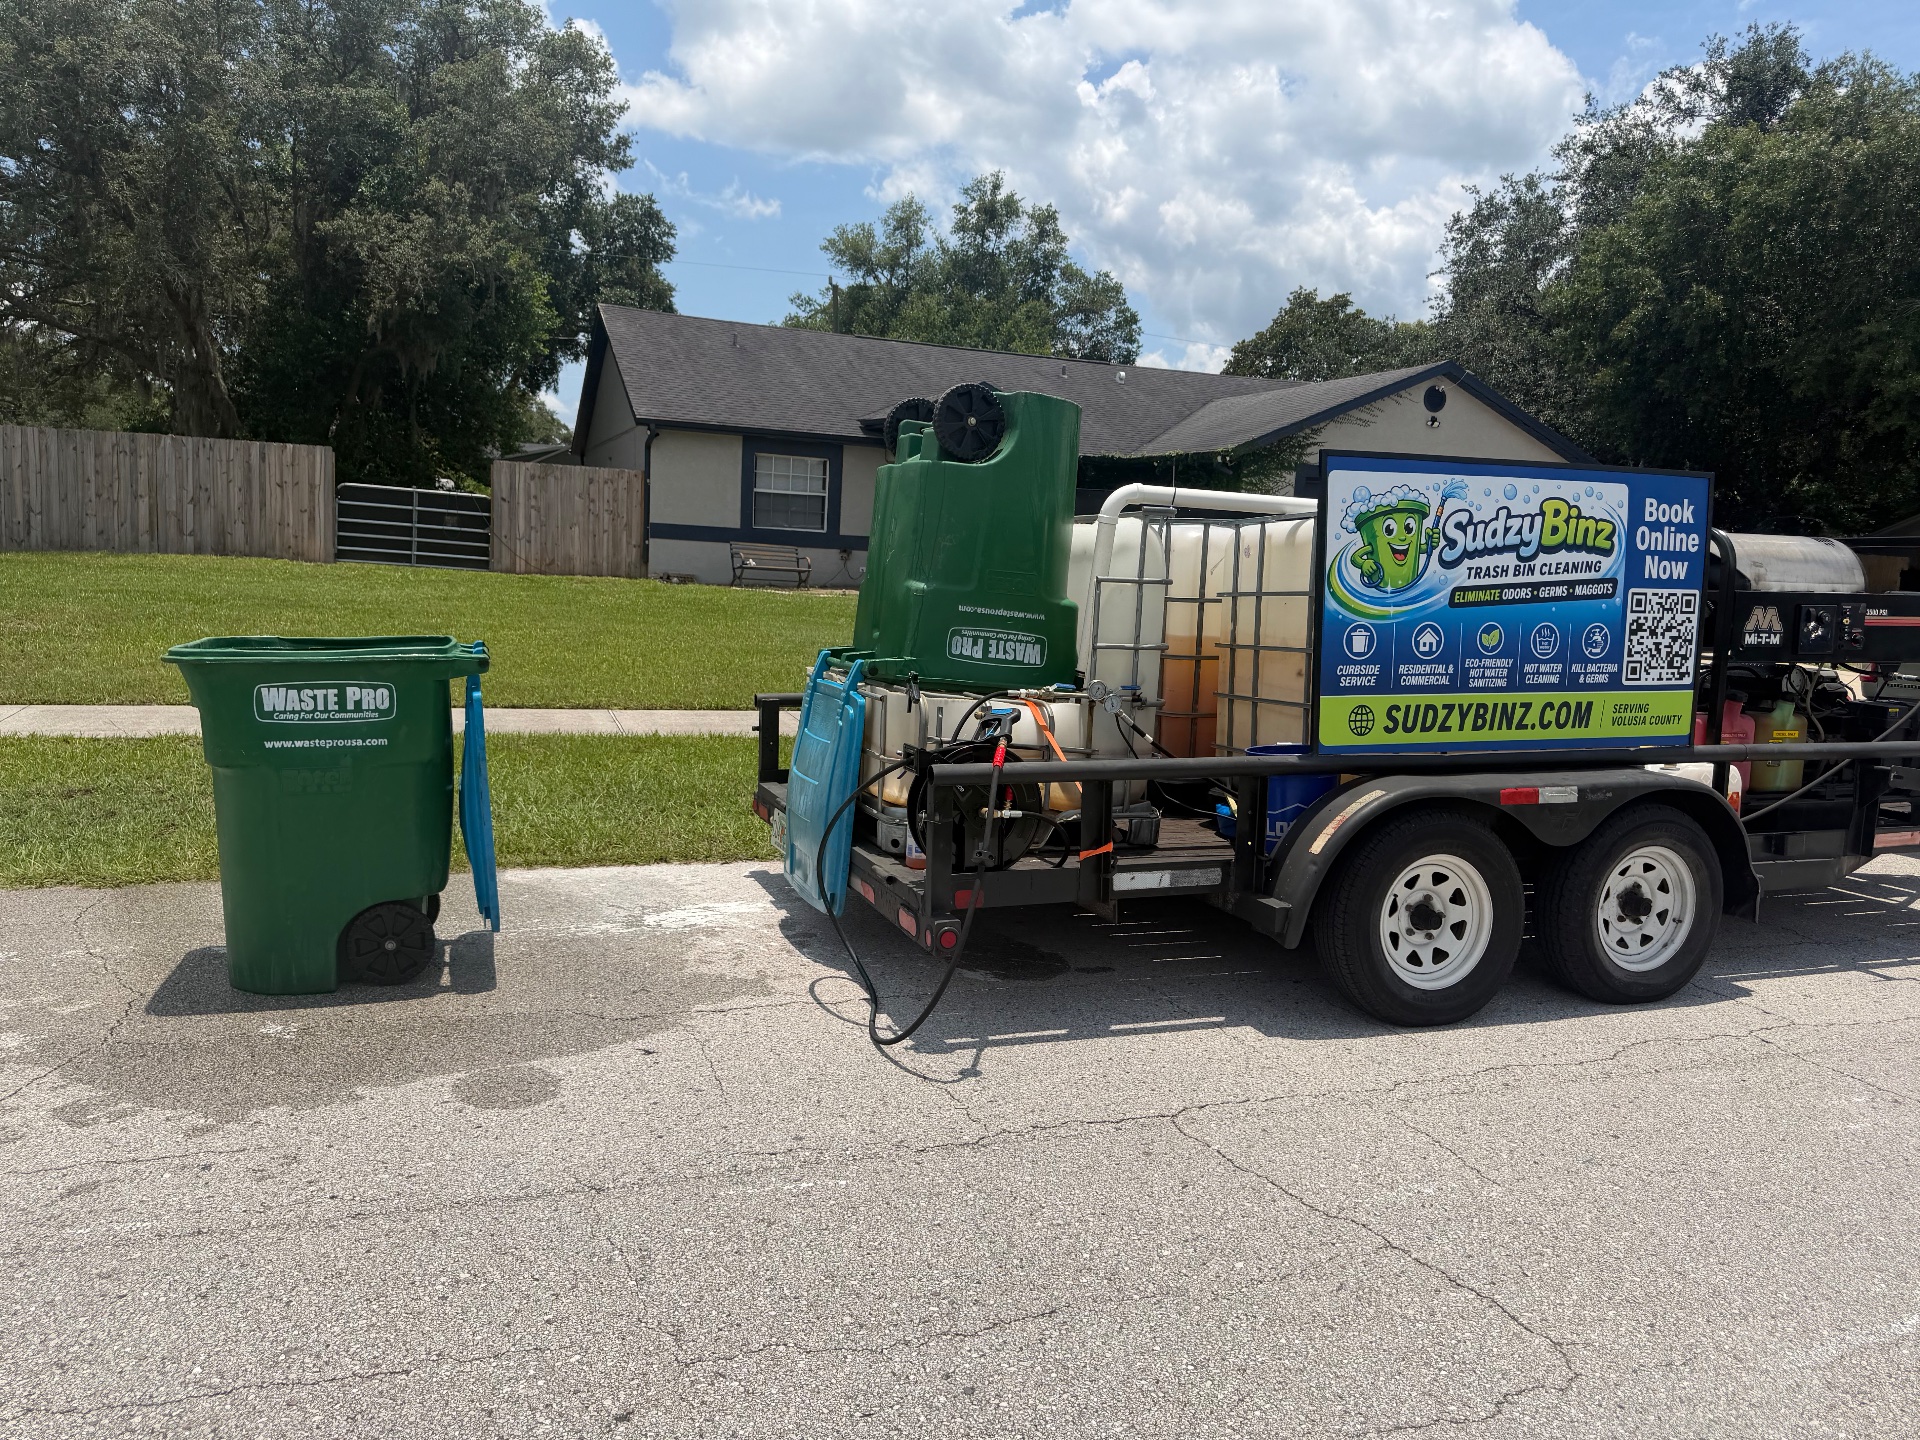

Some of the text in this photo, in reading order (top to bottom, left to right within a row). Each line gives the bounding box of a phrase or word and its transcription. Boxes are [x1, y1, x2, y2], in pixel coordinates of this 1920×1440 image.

[1644, 497, 1695, 524] Book
[1440, 498, 1615, 565] SudzyBinz
[1636, 525, 1700, 553] Online
[1466, 560, 1602, 580] TRASH BIN CLEANING
[1644, 555, 1689, 580] Now
[1454, 583, 1613, 603] ELIMINATE ODORS GERMS MAGGOTS
[958, 604, 1045, 620] www.wasteprousa.com
[961, 629, 997, 638] Communities
[1744, 632, 1780, 645] Mi-T-M
[951, 635, 1041, 665] WASTE PRO
[1465, 658, 1514, 668] ECO-FRIENDLY
[1524, 663, 1563, 673] HOT WATER
[1571, 663, 1618, 673] KILL BACTERIA
[1336, 664, 1381, 676] CURBSIDE
[1398, 664, 1454, 675] RESIDENTIAL &
[1469, 668, 1508, 678] HOT WATER
[1339, 676, 1377, 687] SERVICE
[1400, 675, 1451, 686] COMMERCIAL
[1468, 678, 1508, 688] SANITIZING
[1525, 674, 1560, 684] CLEANING
[1578, 674, 1609, 684] & GERMS
[260, 686, 390, 712] WASTE PRO
[1611, 703, 1650, 714] SERVING
[273, 710, 379, 720] Caring For Our Communities
[1383, 700, 1594, 734] SUDZYBINZ.COM
[1611, 714, 1683, 727] VOLUSIA COUNTY
[264, 738, 388, 748] www.wasteprousa.com
